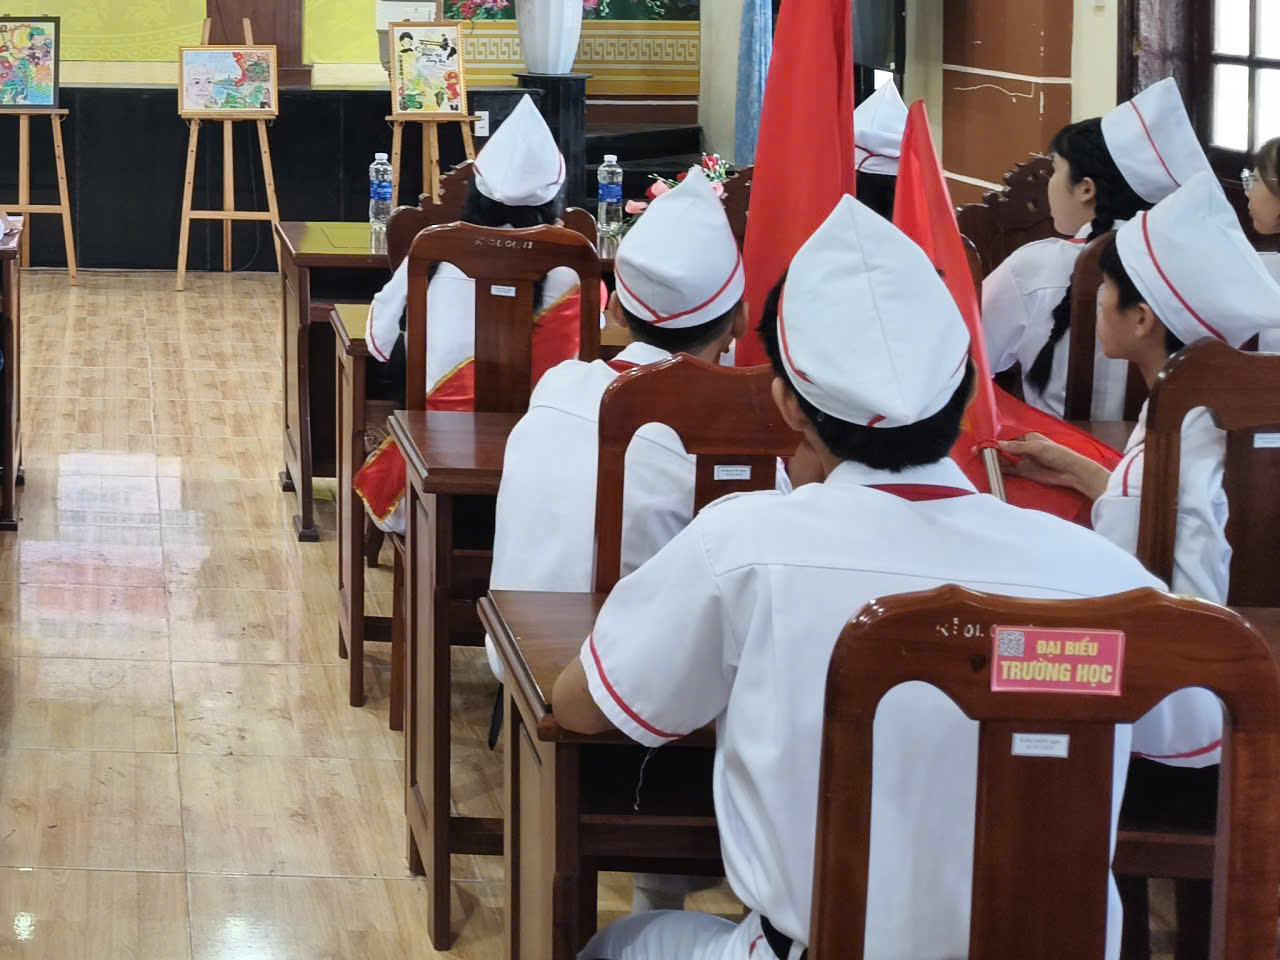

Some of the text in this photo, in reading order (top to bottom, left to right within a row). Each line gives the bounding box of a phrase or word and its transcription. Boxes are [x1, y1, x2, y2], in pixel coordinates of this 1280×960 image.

[1036, 636, 1099, 658] ĐẠI BIỂU
[1000, 658, 1113, 687] TRƯỜNG HỌC
